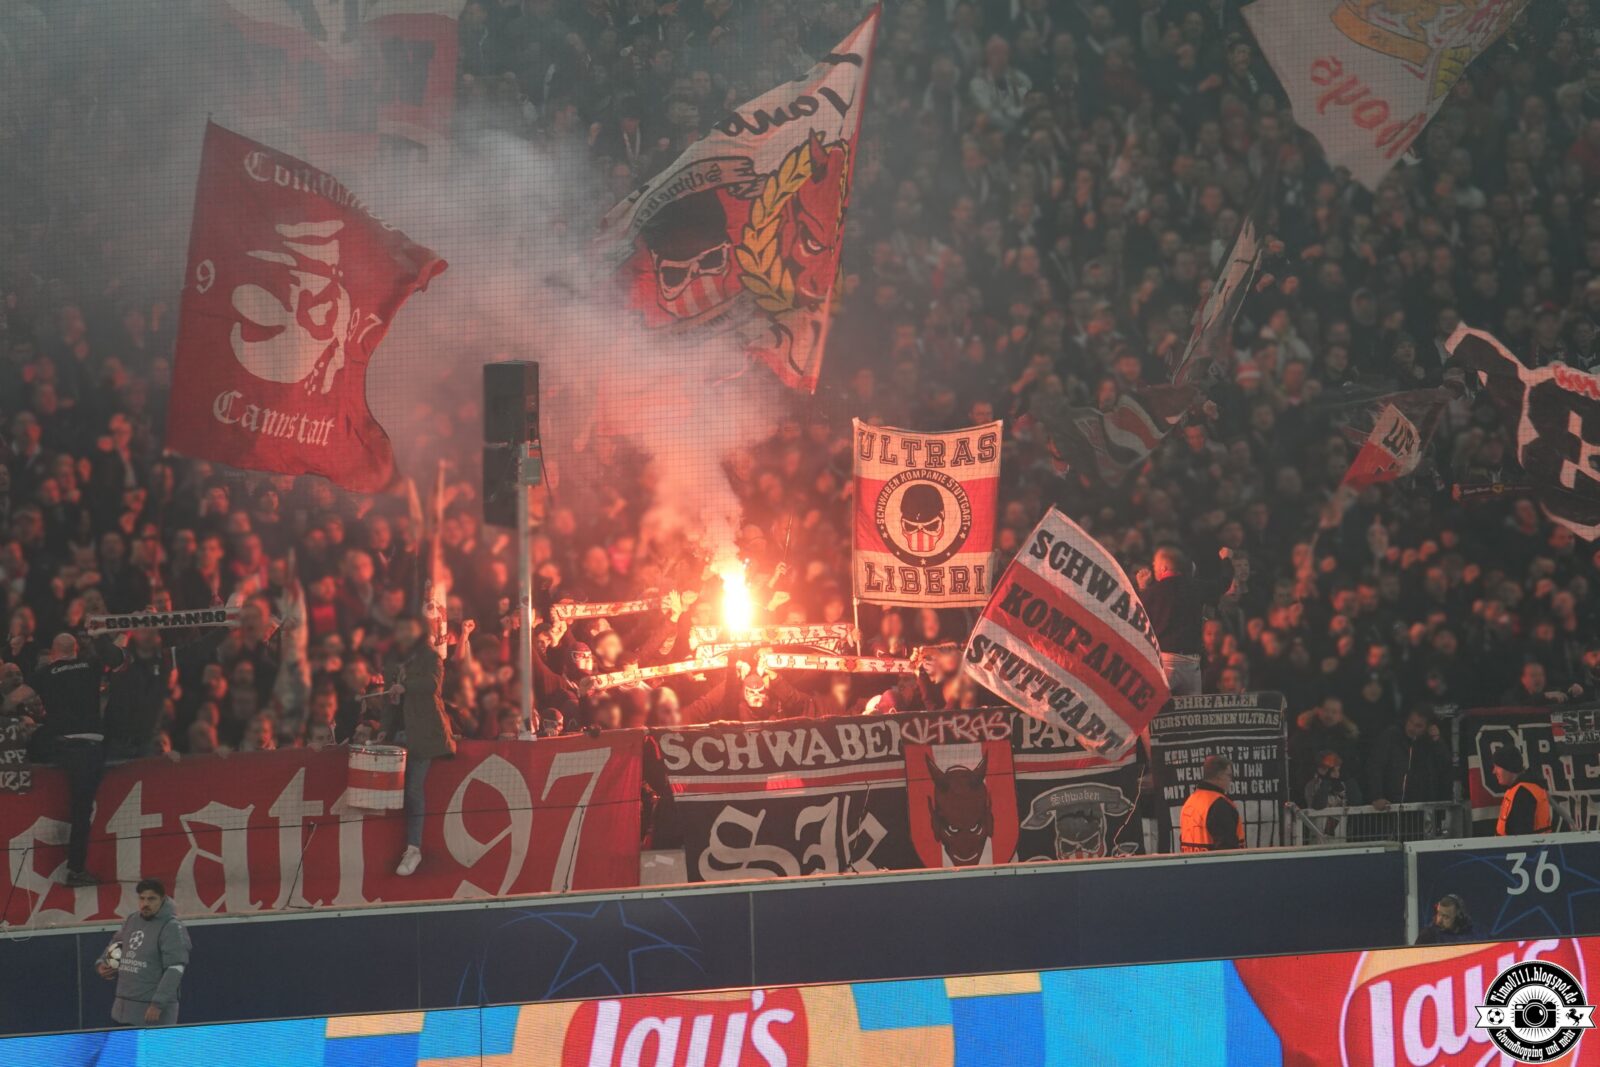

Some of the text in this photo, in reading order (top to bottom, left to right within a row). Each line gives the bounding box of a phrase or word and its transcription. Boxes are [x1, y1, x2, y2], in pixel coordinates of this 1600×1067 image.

[347, 307, 382, 345] 97
[213, 389, 335, 446] Cannstatt
[858, 430, 997, 468] ULTRAS
[876, 469, 971, 525] SCHWABEN KOMPANIE STUTTGART
[865, 562, 985, 596] LIBERI
[105, 610, 227, 630] COMMANDO
[765, 654, 913, 672] ULTRA
[999, 582, 1156, 711] KOMPANIE
[966, 634, 1126, 751] STUTTGART
[1174, 694, 1258, 710] EHRE ALLEN
[901, 712, 1012, 745] ULTRAS
[1152, 712, 1280, 730] VERSTORBENEN ULTRAS
[1244, 763, 1264, 777] IHN
[1050, 790, 1100, 804] Schwaben
[1163, 786, 1189, 800] MIT
[1251, 779, 1280, 794] GEHT
[443, 746, 613, 900] 97
[1505, 851, 1561, 896] 36
